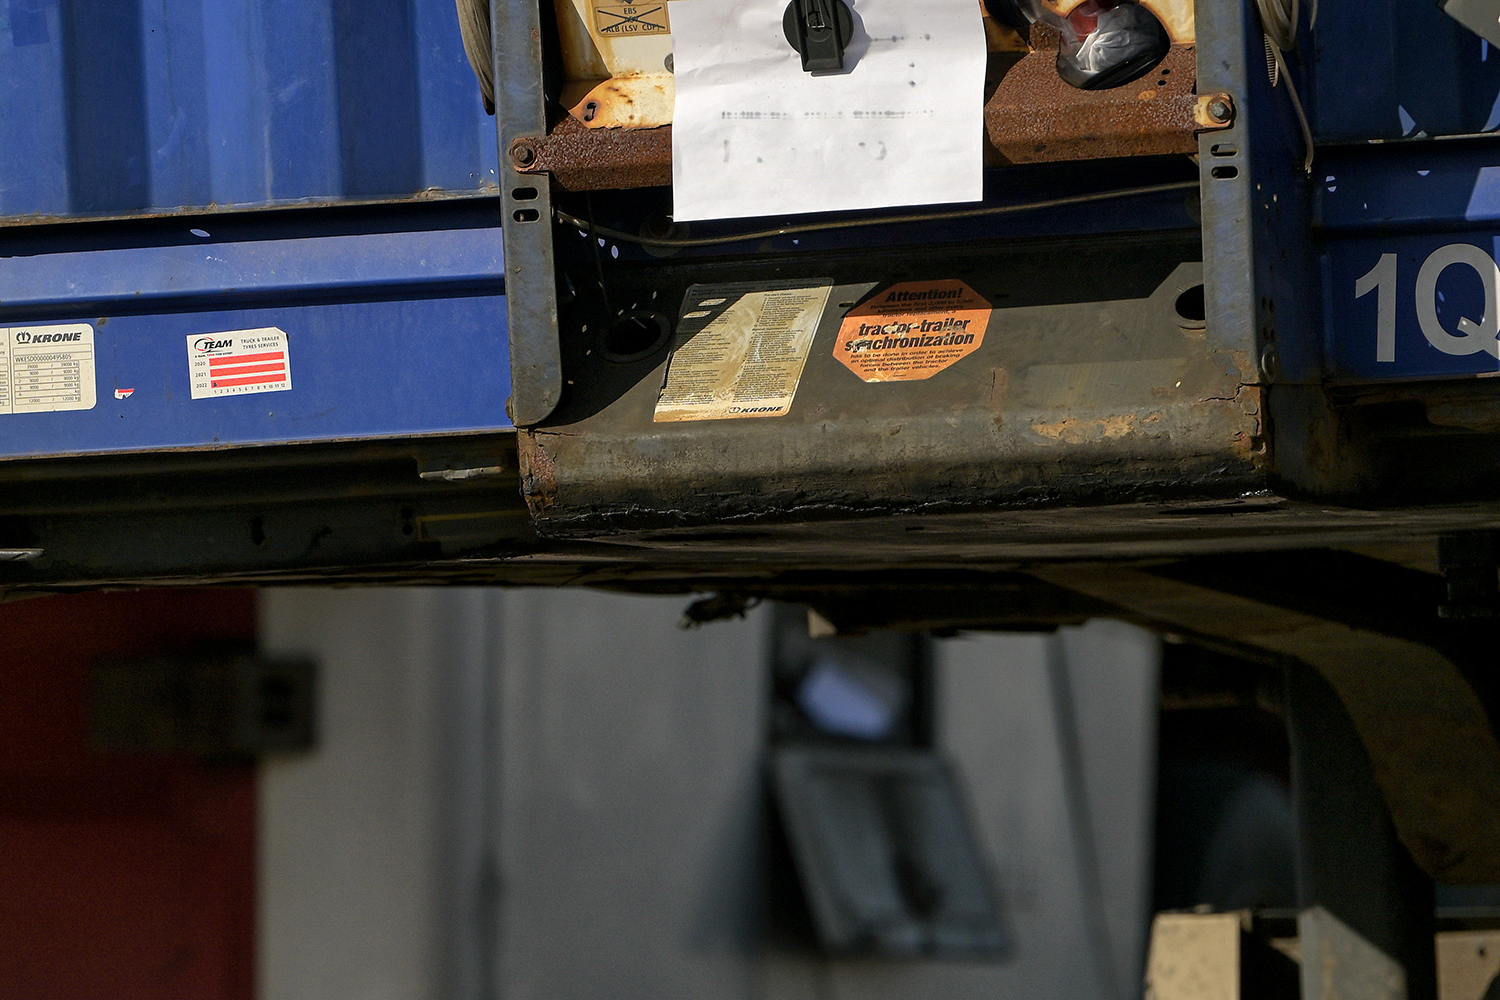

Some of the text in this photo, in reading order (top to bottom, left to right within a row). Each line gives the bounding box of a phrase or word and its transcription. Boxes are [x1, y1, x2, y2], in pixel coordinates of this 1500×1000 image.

[623, 7, 637, 15] EBS
[621, 24, 638, 33] (LSV
[885, 288, 963, 302] Attention!
[1355, 243, 1500, 362] 1Q
[31, 332, 82, 344] KRONE
[203, 339, 233, 350] TEAM
[741, 405, 784, 413] KRONE
